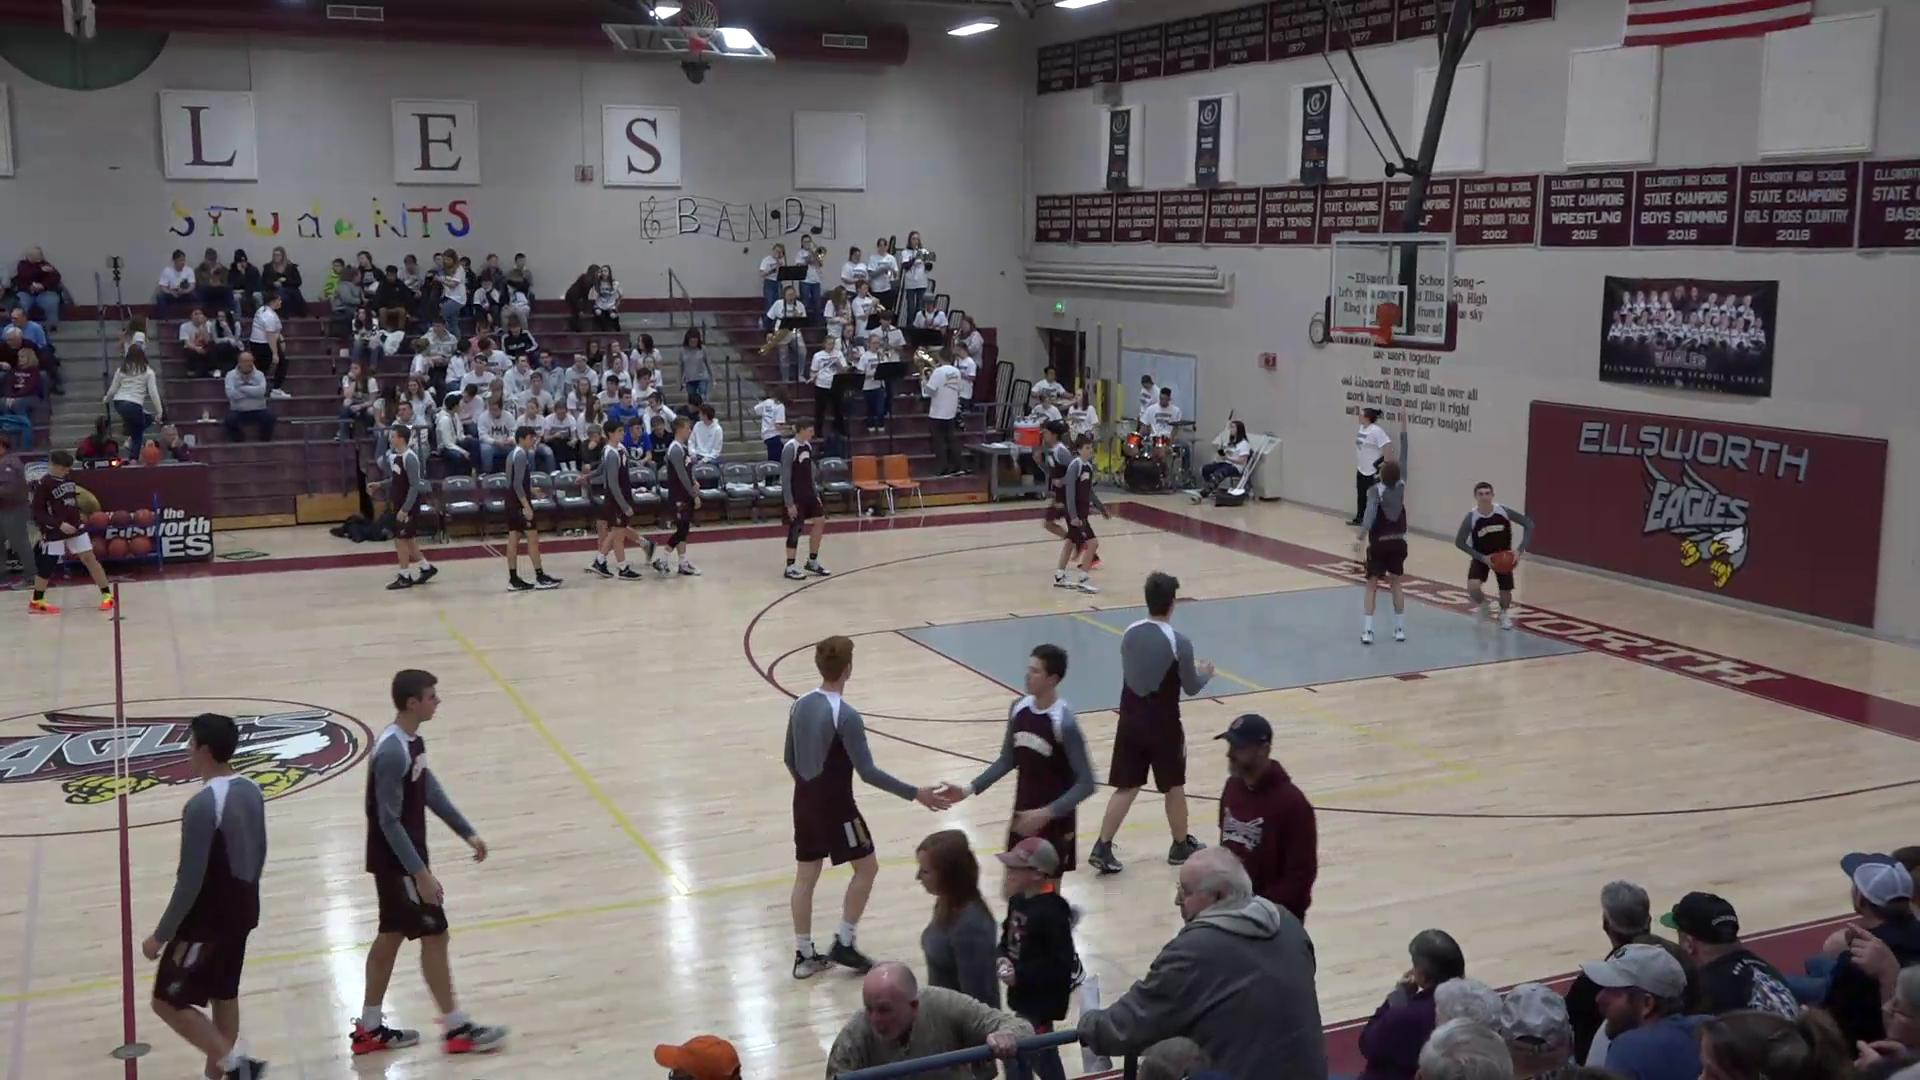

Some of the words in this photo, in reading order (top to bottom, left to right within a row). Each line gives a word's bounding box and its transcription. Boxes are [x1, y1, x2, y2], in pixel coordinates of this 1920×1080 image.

[181, 105, 237, 167] L
[411, 112, 462, 172] E
[625, 117, 662, 175] S
[1750, 171, 1794, 183] ELLSWORTH
[1817, 169, 1846, 182] SCHOOL
[1550, 195, 1575, 207] STATE
[1578, 193, 1624, 207] CHAMPIONS
[1643, 192, 1672, 206] STATE
[1674, 191, 1728, 205] CHAMPIONS
[1749, 189, 1783, 203] STATE
[1786, 188, 1848, 203] CHAMPIONS
[1872, 186, 1911, 201] STATE
[1265, 204, 1282, 214] STATE
[1324, 202, 1343, 212] STATE
[1344, 201, 1378, 212] CHAMPIONS
[1389, 200, 1407, 211] STAT
[1464, 198, 1486, 209] STATE
[1489, 196, 1531, 208] CHAMPIONS
[675, 196, 804, 241] BAND
[1267, 217, 1285, 227] BOYS
[1287, 216, 1312, 227] TENNIS
[1463, 214, 1480, 225] BOYS
[1508, 213, 1530, 225] TRACK
[1551, 211, 1622, 224] WRESTLING
[1640, 211, 1671, 224] BOYS
[1674, 210, 1728, 224] SWIMMING
[1744, 209, 1769, 223] GIRLS
[1772, 209, 1803, 223] CROSS
[1805, 208, 1849, 223] COUNTRY
[1482, 230, 1508, 239] 2002
[1571, 229, 1598, 240] 2015
[1667, 229, 1698, 240] 2016
[1419, 274, 1445, 287] Schoo
[1466, 292, 1488, 306] High
[1409, 351, 1442, 365] together
[1393, 367, 1416, 378] never
[1413, 384, 1428, 394] will
[1447, 388, 1465, 399] over
[1467, 388, 1478, 401] all
[1346, 390, 1364, 402] work
[1420, 400, 1437, 413] play
[1448, 403, 1470, 417] right
[1408, 414, 1434, 428] victory
[1437, 416, 1472, 433] tonight!
[1578, 421, 1809, 482] ELLSWORTH
[163, 508, 185, 519] the
[1643, 480, 1750, 533] EAGLES
